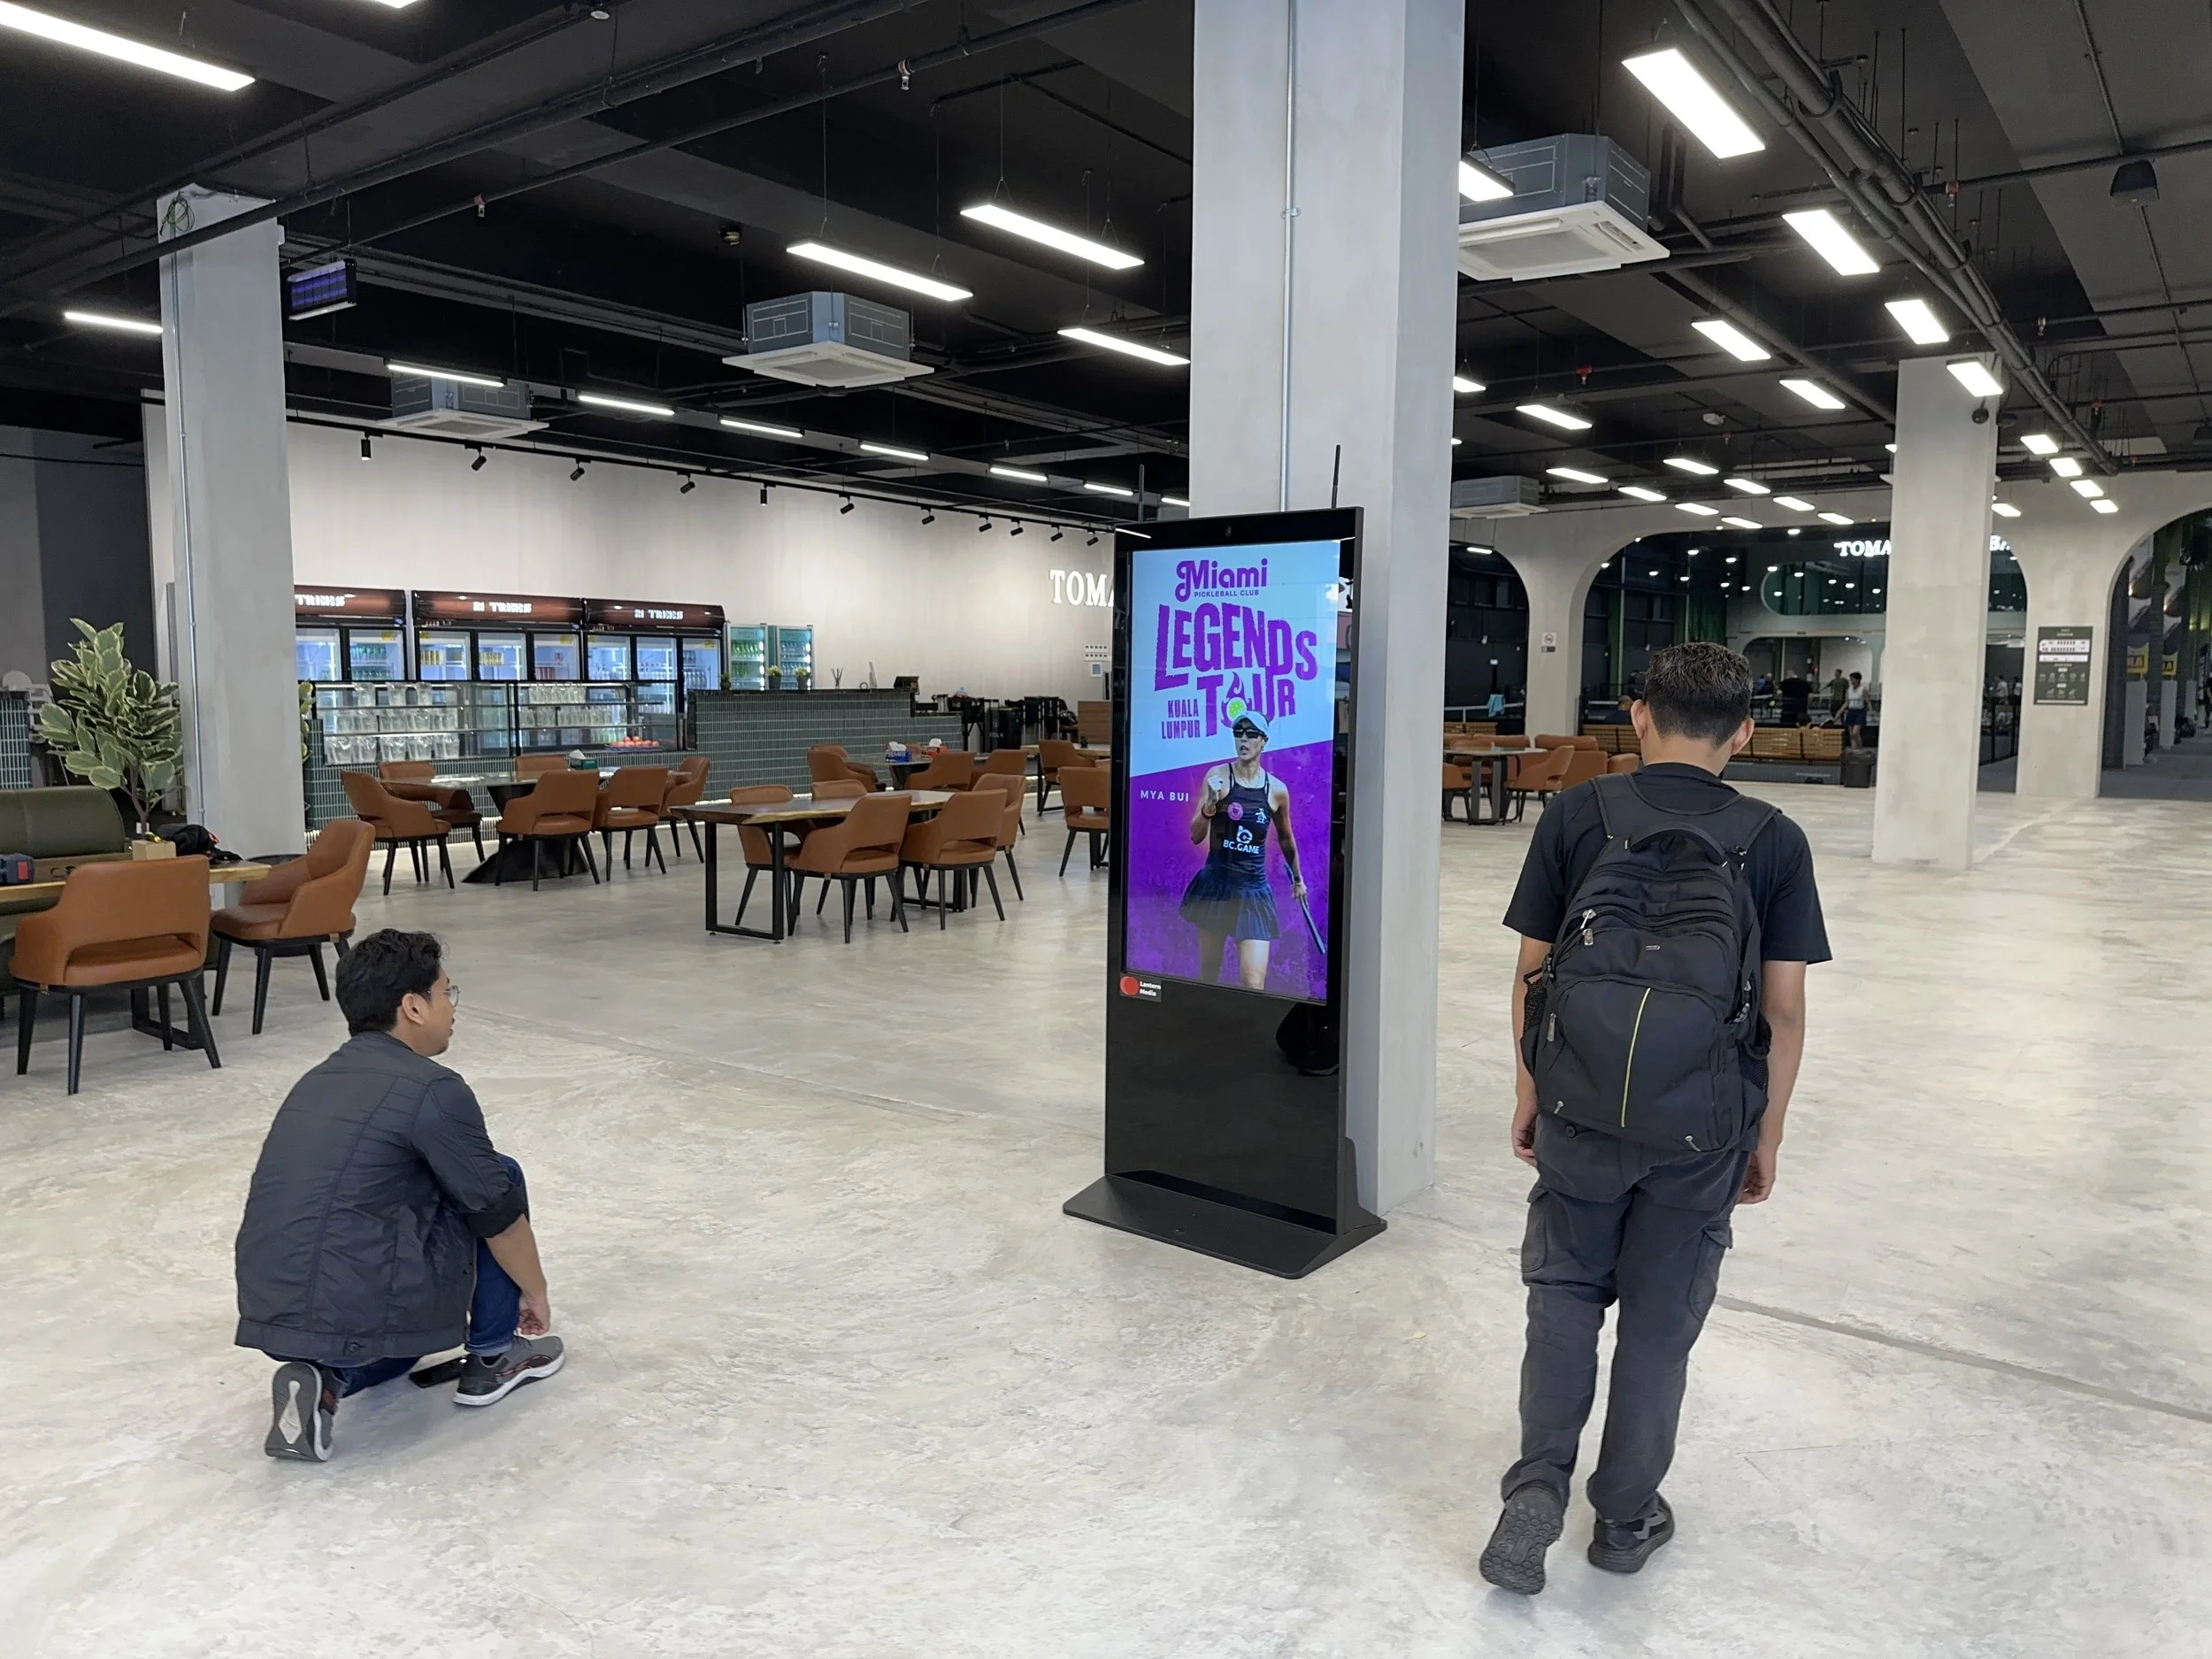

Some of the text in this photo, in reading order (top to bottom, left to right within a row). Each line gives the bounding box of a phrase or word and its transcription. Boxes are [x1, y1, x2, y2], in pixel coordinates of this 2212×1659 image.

[1175, 557, 1268, 602] Miami
[1155, 603, 1318, 691] LEGENDS
[1167, 699, 1199, 718] KUALA
[1161, 720, 1201, 739] LUMPUR
[1140, 789, 1189, 803] MYA BUI
[1223, 839, 1261, 854] BC.GAME
